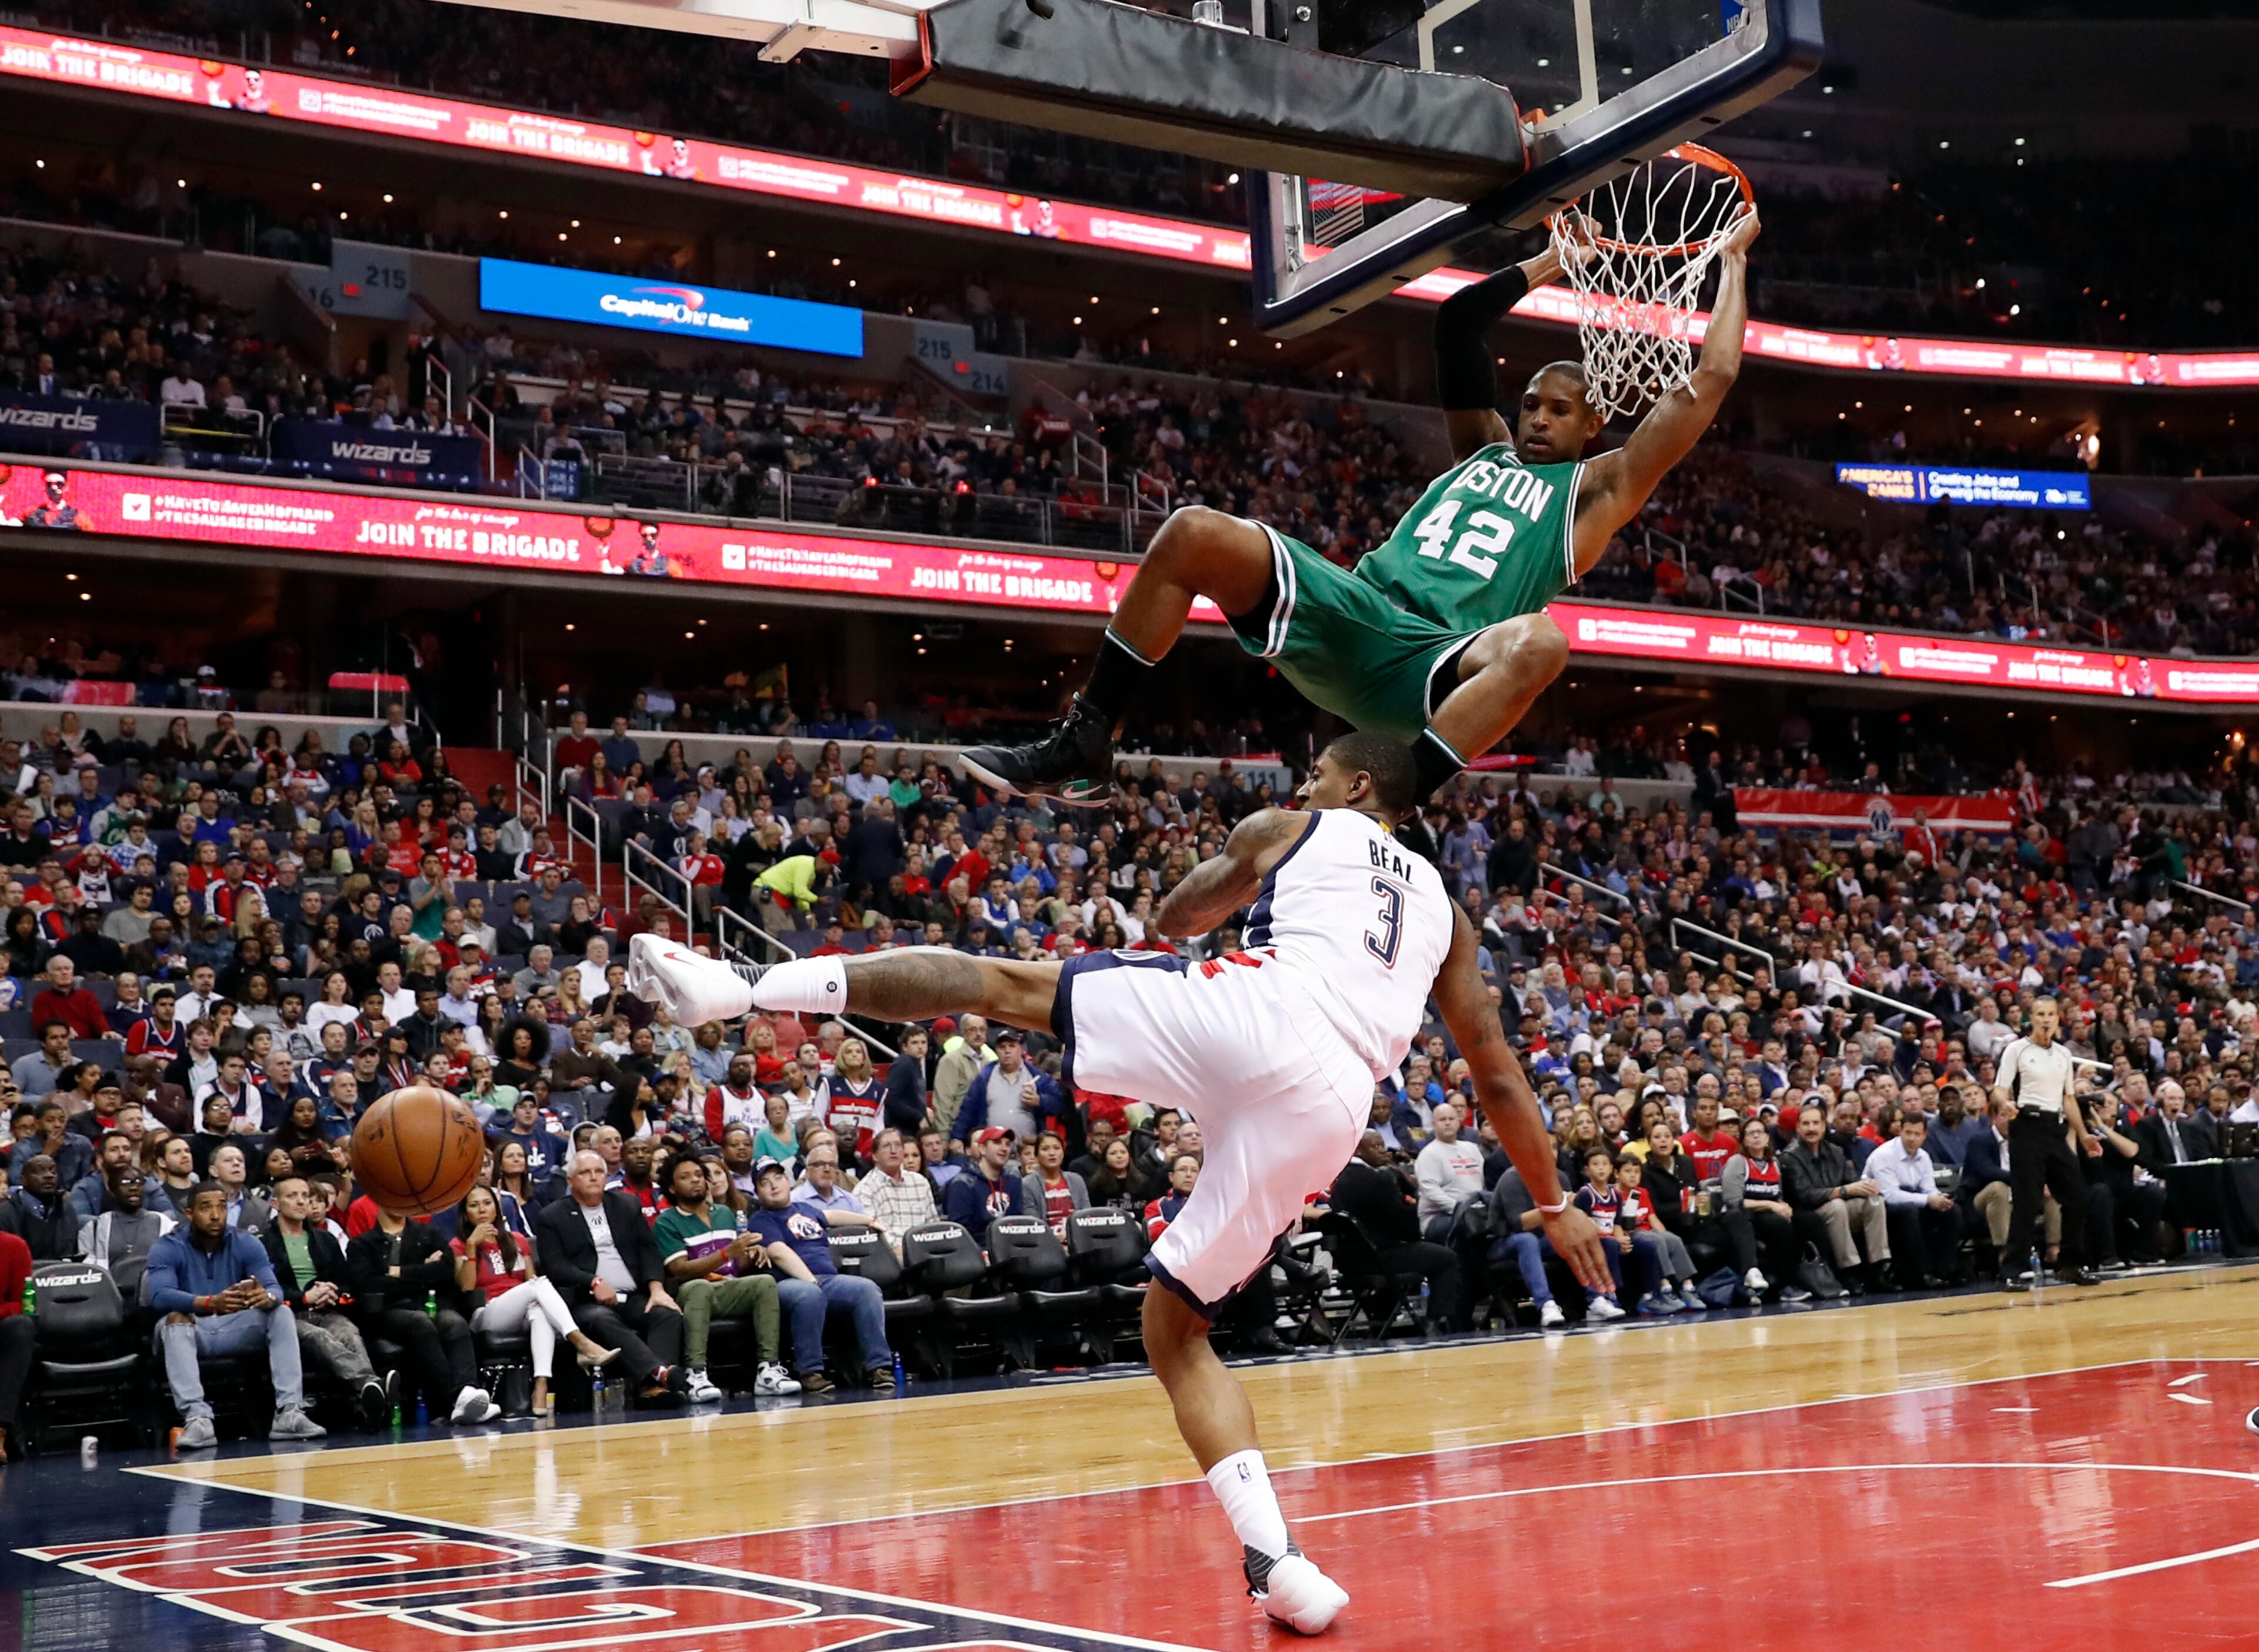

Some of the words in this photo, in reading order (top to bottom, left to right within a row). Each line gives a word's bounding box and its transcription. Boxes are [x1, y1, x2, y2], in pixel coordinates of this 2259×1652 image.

[1, 45, 51, 71] JOIN
[55, 54, 97, 78] THE
[99, 62, 194, 95] BRIGADE
[465, 121, 509, 143] JOIN
[512, 127, 548, 149] THE
[549, 134, 629, 164] BRIGADE
[861, 185, 899, 205] JOIN
[901, 190, 932, 210] THE
[365, 265, 407, 290] 215
[308, 287, 334, 308] 16
[708, 313, 750, 332] Bank
[918, 337, 952, 359] 215
[971, 370, 1005, 392] 214
[331, 438, 431, 465] wizards
[1442, 460, 1554, 522] OSTON
[1928, 471, 1972, 488] Creating
[1973, 474, 2000, 488] Jobs
[2001, 475, 2020, 488] and
[1974, 487, 1991, 500] the
[1991, 487, 2040, 505] Economy
[356, 520, 415, 547] JOIN
[420, 524, 468, 551] THE
[472, 531, 581, 561] BRIGADE
[1413, 500, 1515, 579] 42
[911, 567, 959, 591] JOIN
[961, 571, 1002, 594] THE
[1005, 575, 1094, 602] BRIGADE
[1707, 635, 1742, 655] JOIN
[1742, 638, 1771, 658] THE
[1771, 641, 1834, 664] BRIGADE
[1368, 838, 1413, 884] BEAL
[1364, 875, 1405, 970] 3
[998, 1222, 1046, 1234] wizards
[1076, 1213, 1125, 1226] wizards
[828, 1230, 878, 1245] wizards
[912, 1227, 963, 1242] wizards
[35, 1269, 103, 1287] wizards
